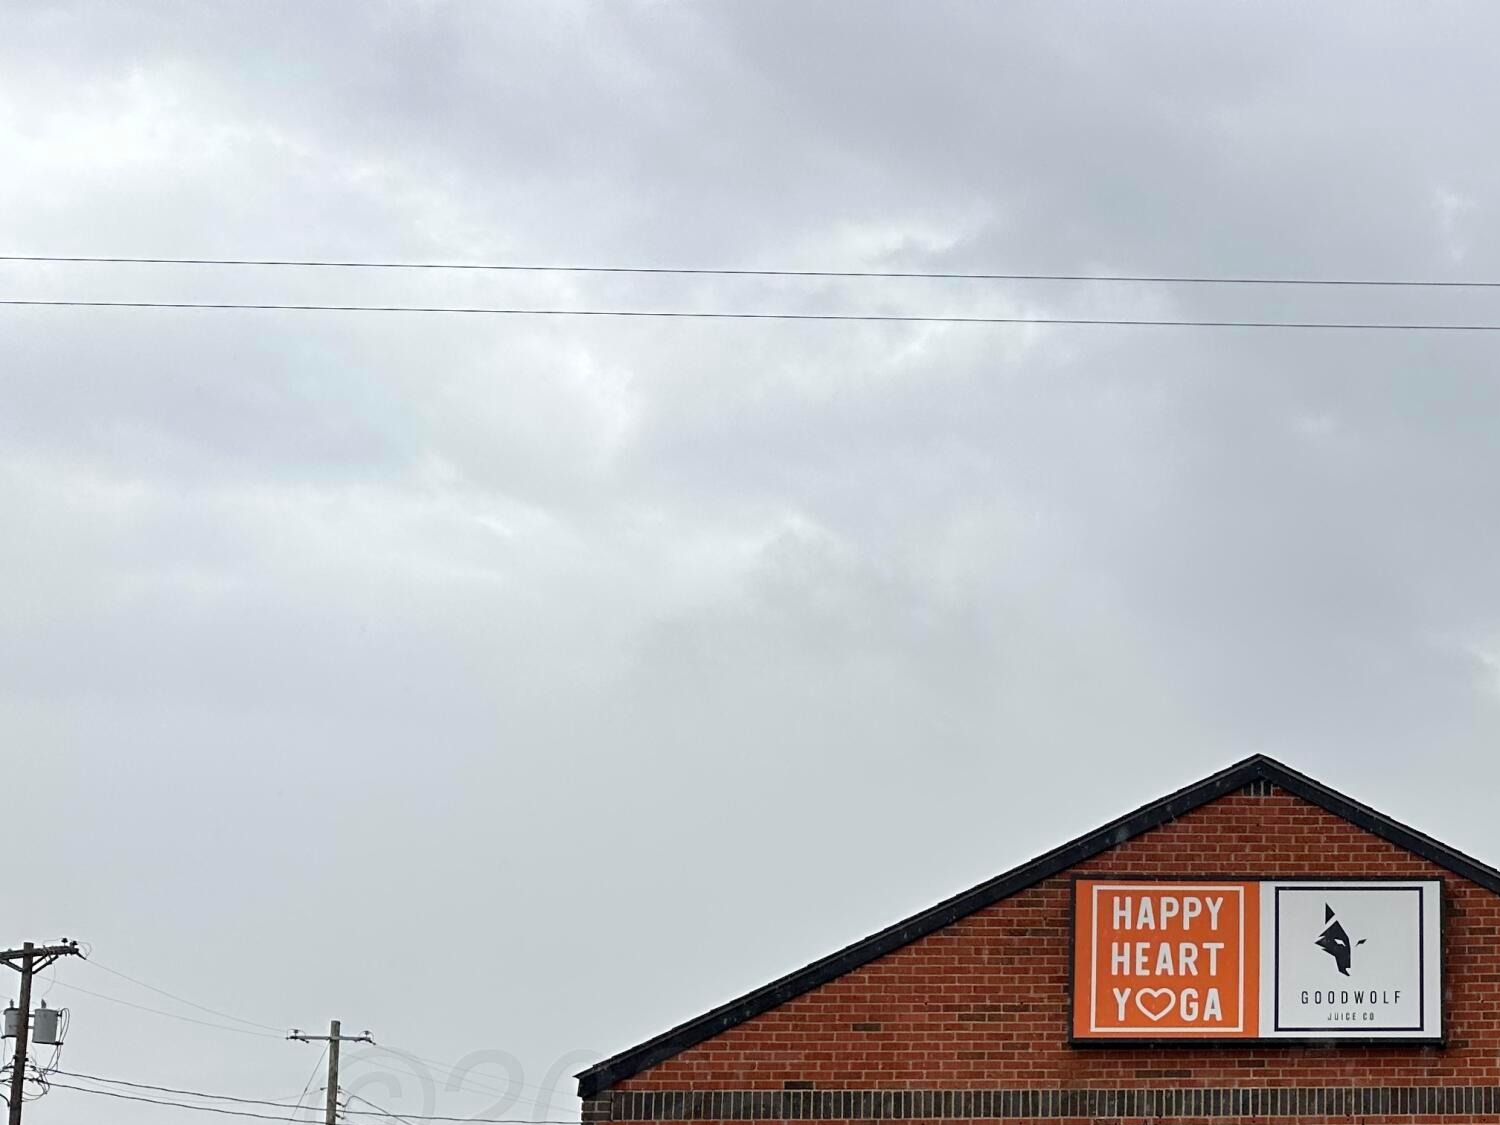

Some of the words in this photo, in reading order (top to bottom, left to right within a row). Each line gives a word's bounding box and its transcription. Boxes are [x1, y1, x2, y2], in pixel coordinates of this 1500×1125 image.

[1112, 896, 1223, 930] HAPPY
[1111, 942, 1225, 976] HEART
[1301, 990, 1401, 1005] GOODWOLF
[1327, 1012, 1357, 1021] JUICE
[1362, 1012, 1375, 1021] CO
